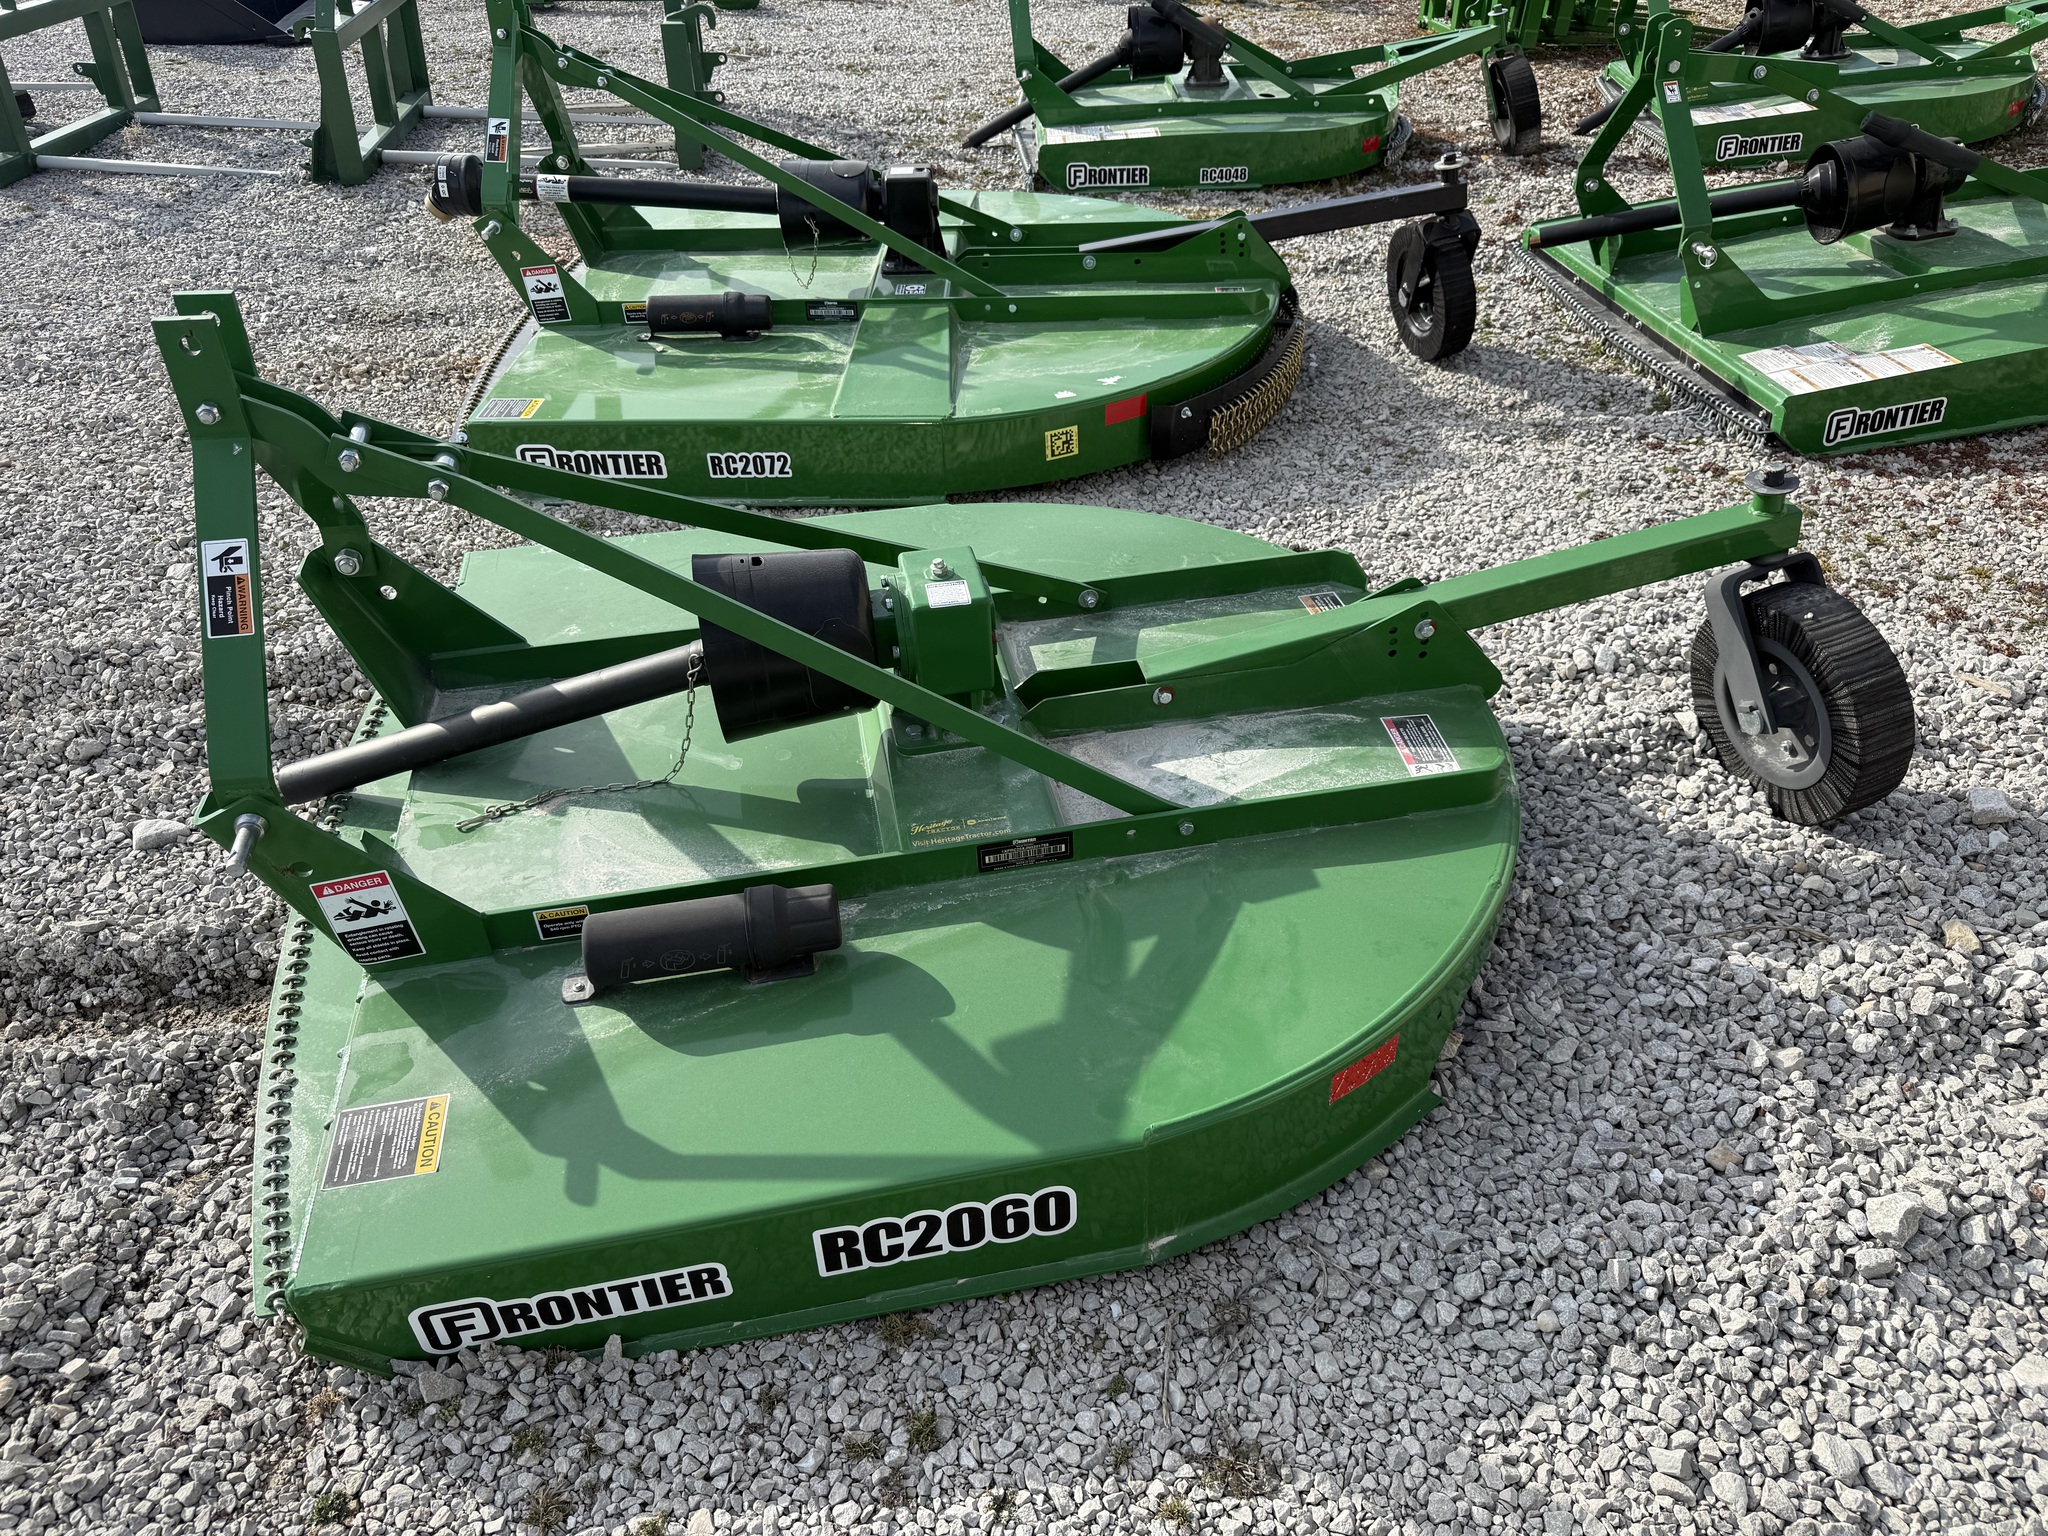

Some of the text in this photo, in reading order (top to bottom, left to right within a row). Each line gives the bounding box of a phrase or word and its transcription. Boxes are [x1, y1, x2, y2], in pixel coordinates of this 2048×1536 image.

[1718, 134, 1801, 159] FRONTIER
[1067, 164, 1148, 188] FRONTIER
[1201, 167, 1247, 182] RC4048
[531, 268, 554, 276] DANGER
[1825, 399, 1945, 443] FRONTIER
[520, 447, 665, 476] FRONTIER
[709, 454, 790, 476] RC2072
[237, 585, 249, 631] WARNING
[910, 819, 953, 836] Heritage
[912, 828, 1011, 848] Visit HeritageTractor.com
[926, 825, 960, 834] TRACTOR
[334, 877, 383, 893] DANGER
[548, 908, 585, 918] CAUTION
[344, 928, 379, 938] Entanglement
[419, 1112, 440, 1168] CAUTION
[818, 1189, 1073, 1274] RC2060
[418, 1266, 728, 1349] FRONTIER
